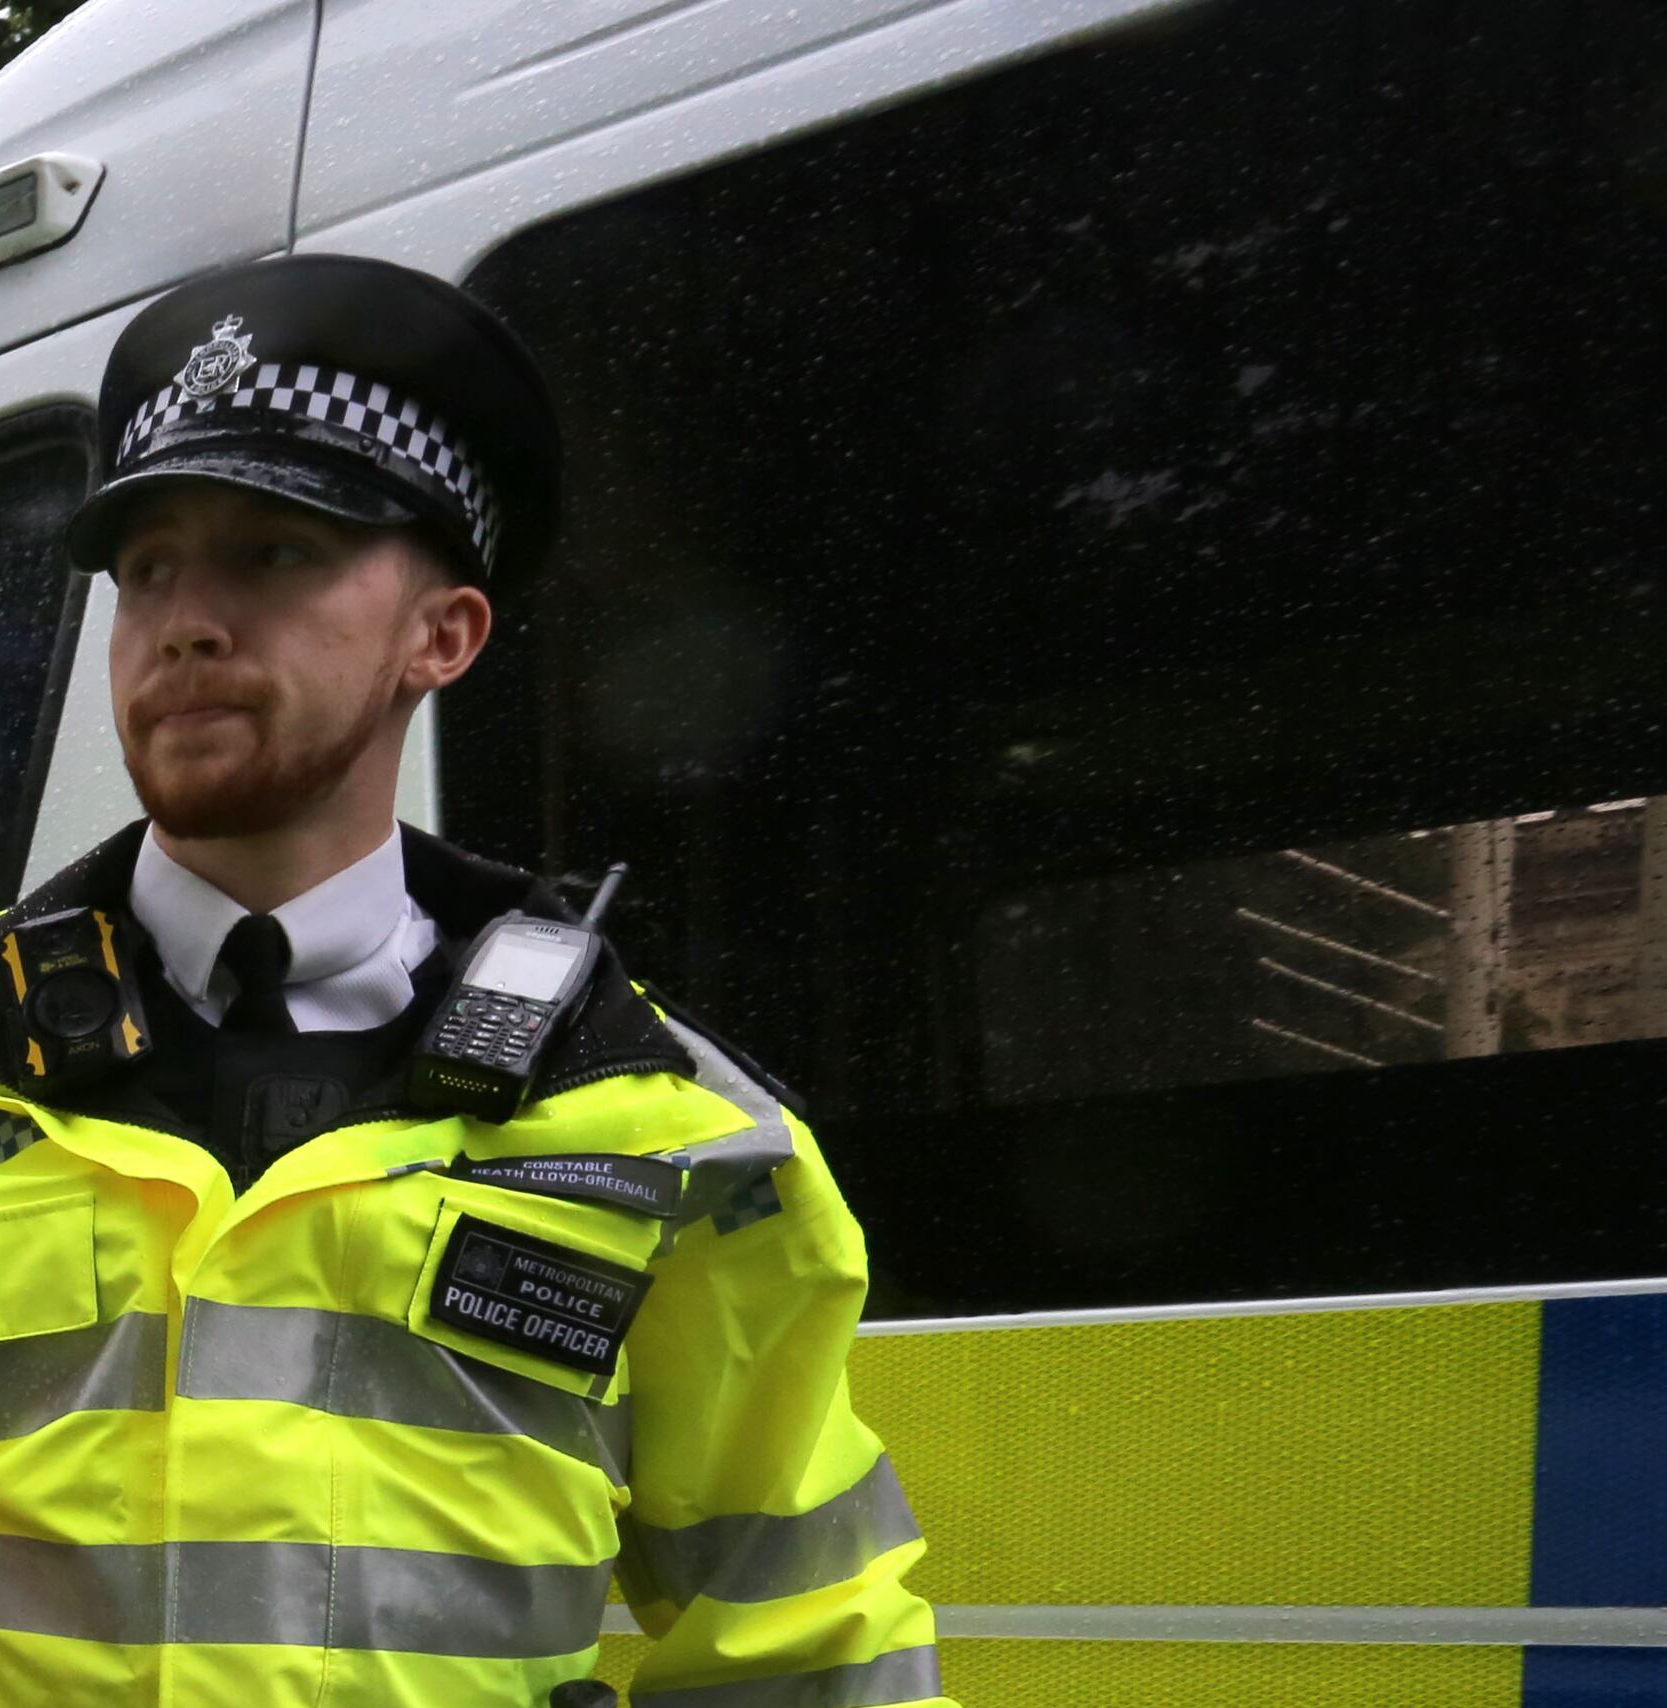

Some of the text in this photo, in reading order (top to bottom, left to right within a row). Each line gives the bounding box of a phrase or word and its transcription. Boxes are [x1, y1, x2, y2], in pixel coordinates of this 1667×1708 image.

[471, 1168, 659, 1202] HEATH LLOYD-GREENALL
[523, 1161, 613, 1174] CONSTABLE
[514, 1256, 625, 1301] METROPOLITAN
[519, 1280, 604, 1319] POLICE
[444, 1286, 611, 1360] POLICE OFFICER
